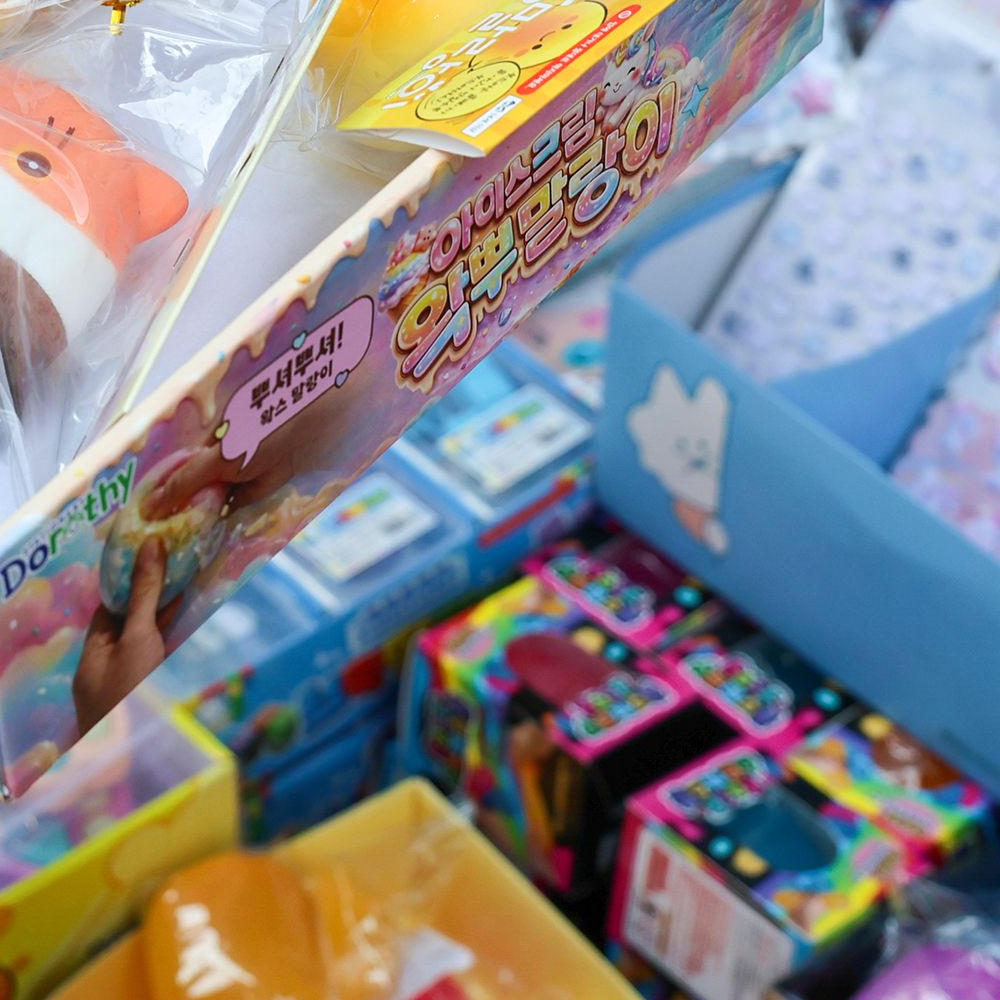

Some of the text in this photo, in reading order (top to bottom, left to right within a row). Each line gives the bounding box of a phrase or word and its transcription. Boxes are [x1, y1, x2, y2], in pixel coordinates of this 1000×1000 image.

[429, 89, 598, 273] 아이스크림
[259, 361, 335, 428] 왁스 말랑이
